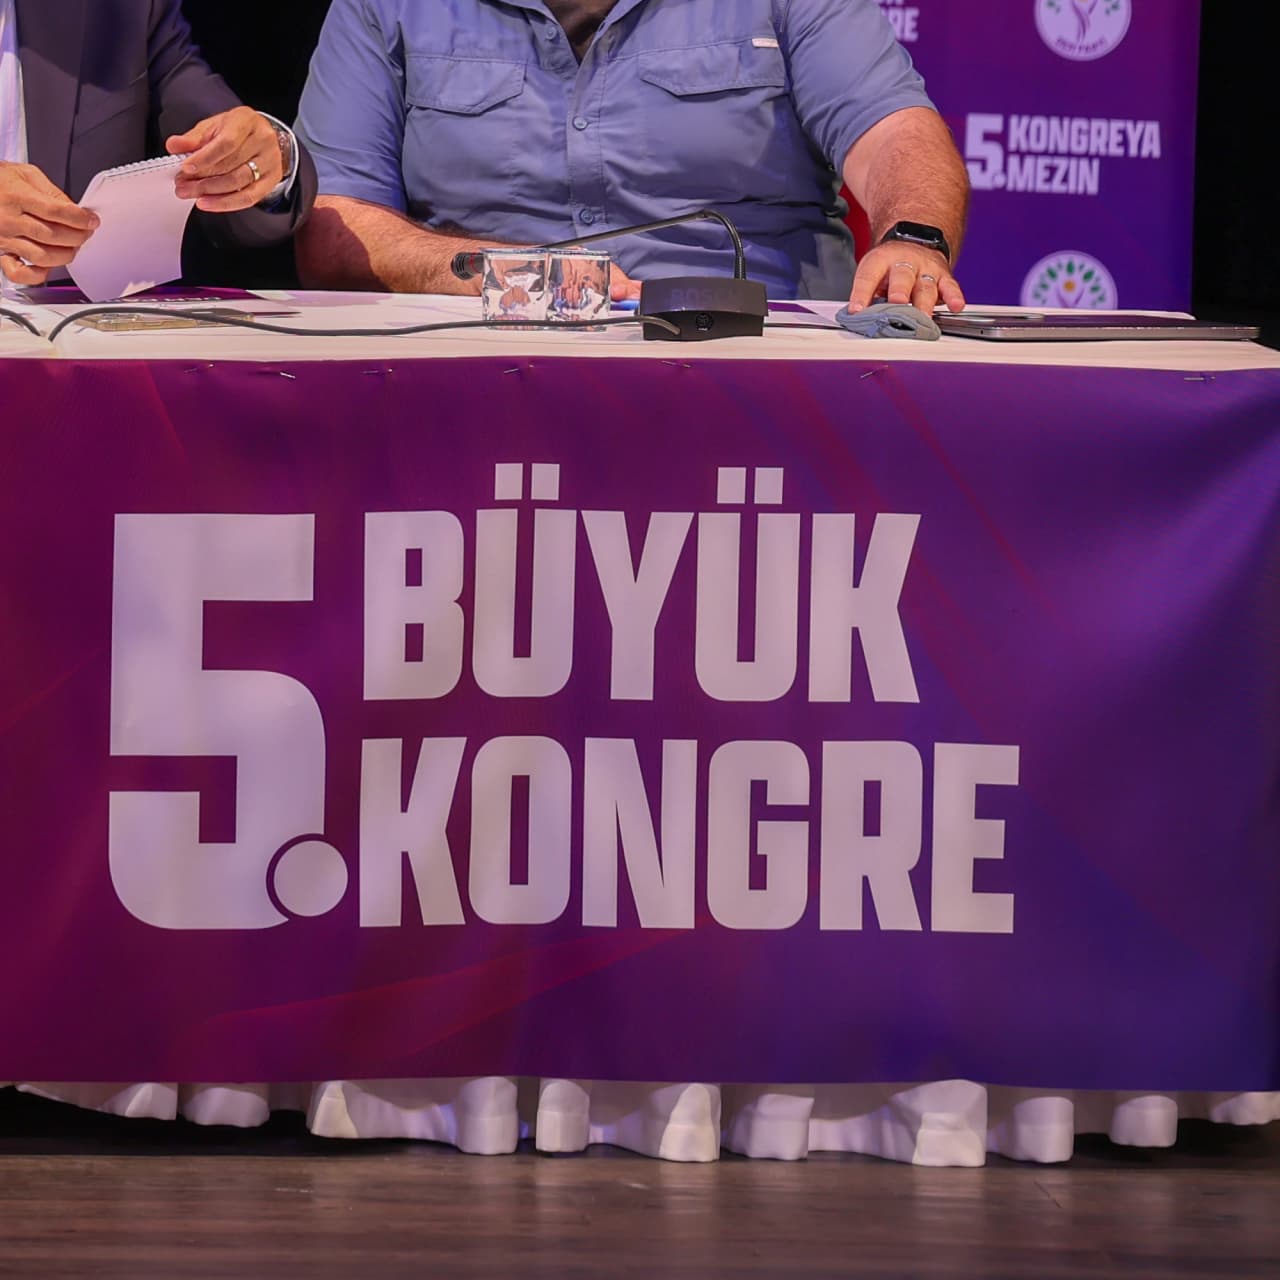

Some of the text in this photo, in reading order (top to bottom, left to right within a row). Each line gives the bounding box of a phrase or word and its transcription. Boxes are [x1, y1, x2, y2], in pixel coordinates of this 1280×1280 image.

[966, 113, 1161, 189] 5. KONGREYA
[1005, 154, 1100, 195] MEZIN
[109, 463, 921, 930] 5. BÜYÜK
[359, 735, 1020, 934] KONGRE
